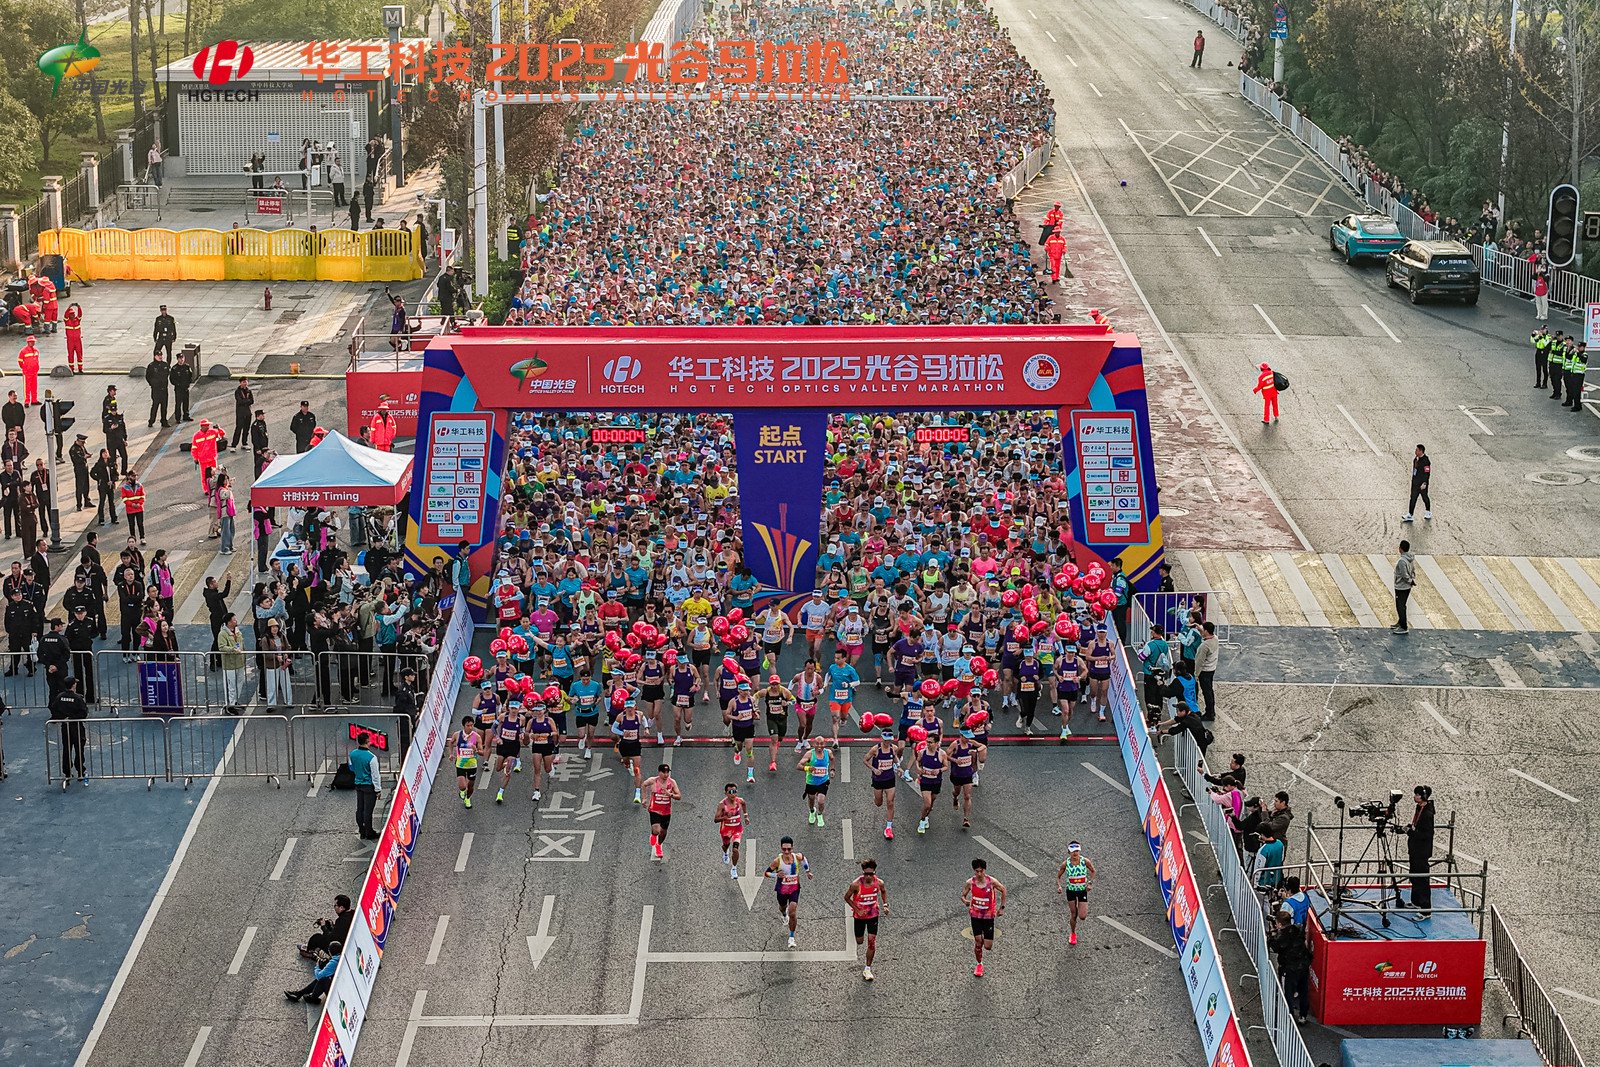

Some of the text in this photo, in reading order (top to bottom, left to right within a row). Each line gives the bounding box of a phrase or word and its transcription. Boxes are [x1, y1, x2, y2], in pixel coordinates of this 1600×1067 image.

[668, 355, 775, 382] 华工科技
[531, 379, 576, 389] 中国光谷
[601, 385, 645, 393] HGTECH
[782, 384, 840, 392] OPTICS
[850, 384, 908, 392] VALLEY
[918, 383, 1004, 392] MARATHON
[451, 427, 484, 436] 华工科技
[916, 428, 969, 442] 00:00:05
[1096, 426, 1130, 435] 华工科技
[592, 429, 645, 443] 00:00:04
[759, 425, 803, 447] 起点
[753, 449, 807, 464] START
[282, 492, 359, 502] 计时计分 Timing
[148, 685, 158, 705] min
[1343, 987, 1382, 997] 华工科技
